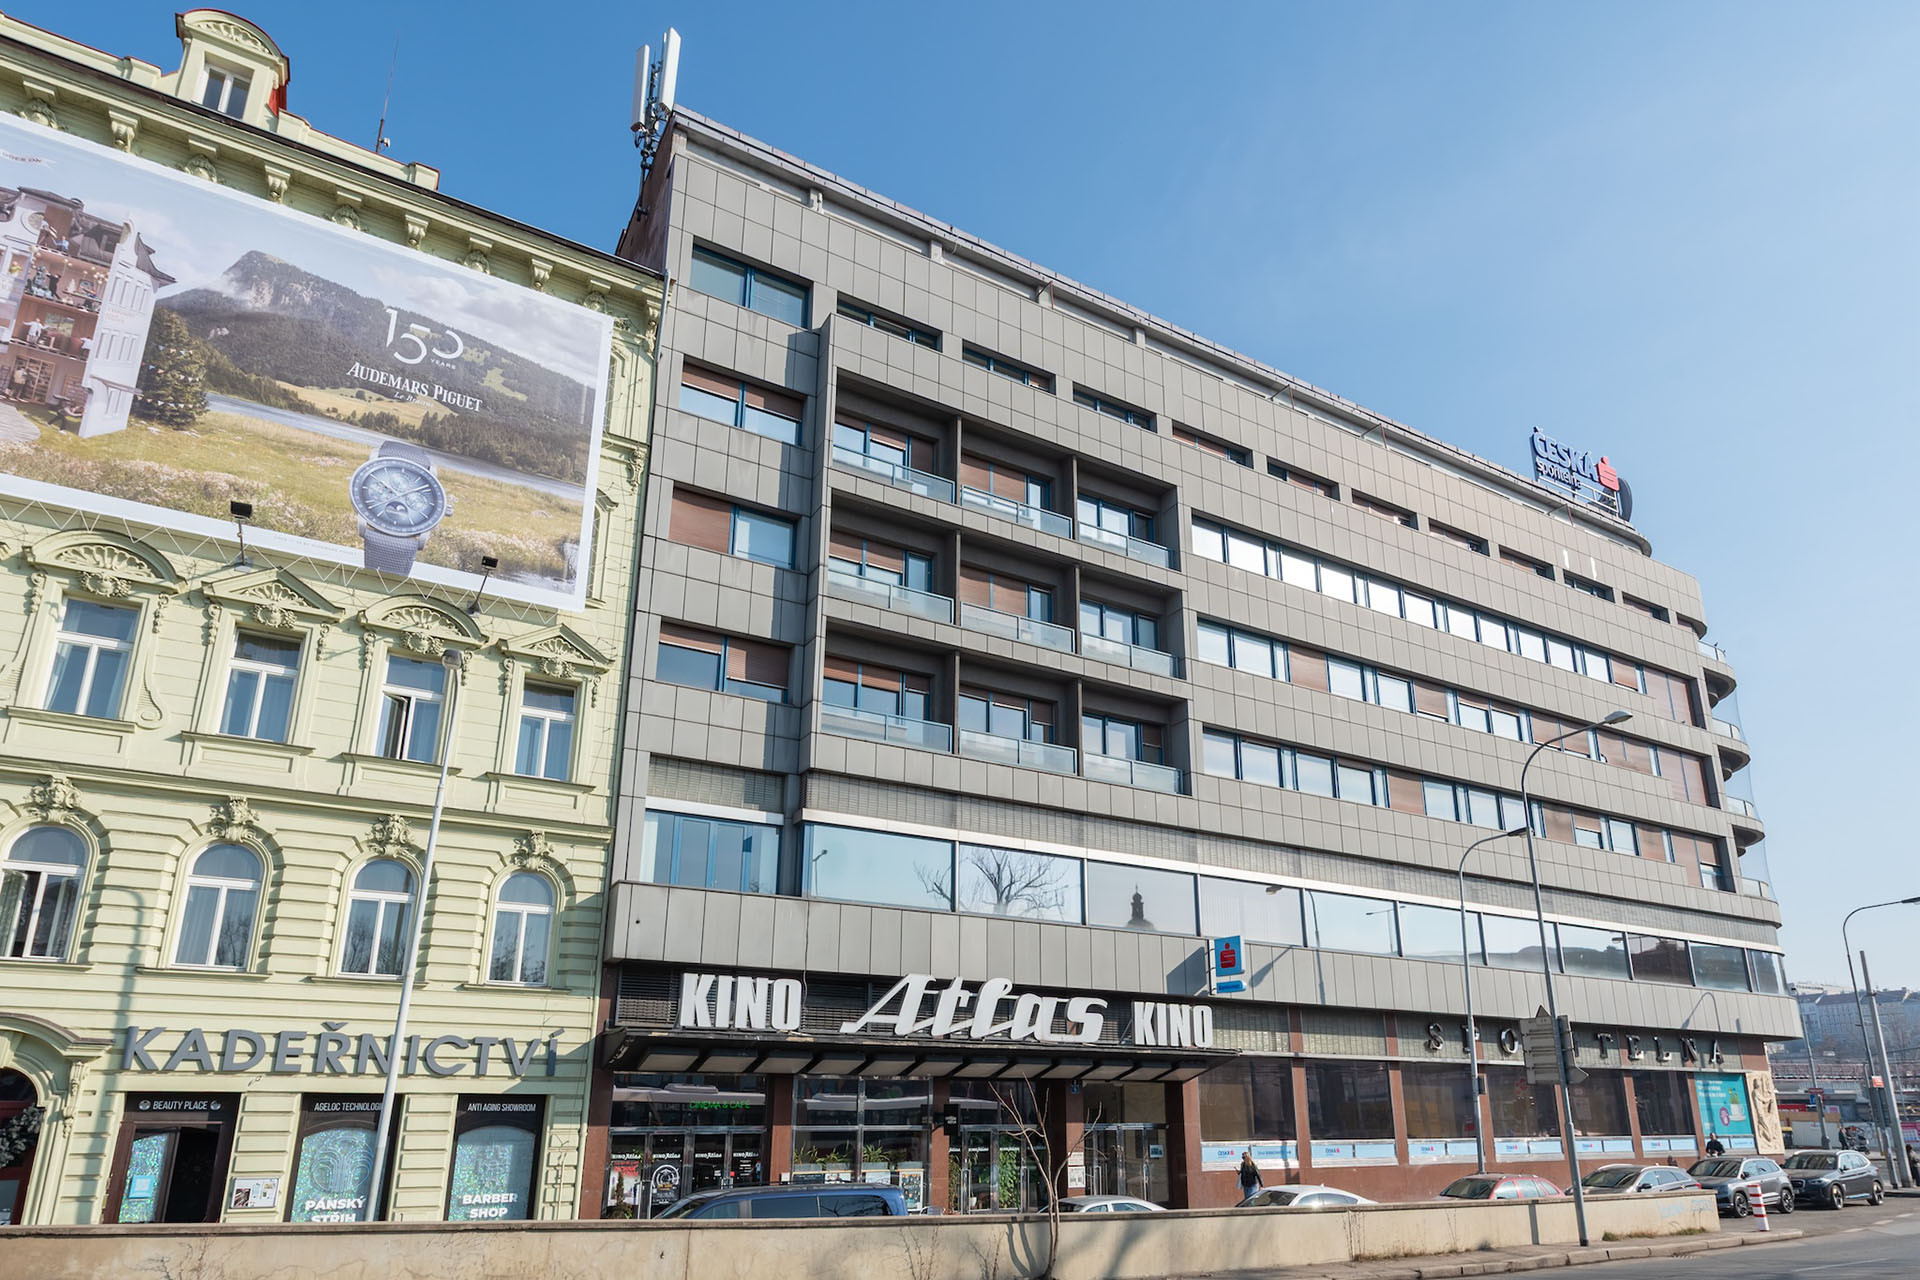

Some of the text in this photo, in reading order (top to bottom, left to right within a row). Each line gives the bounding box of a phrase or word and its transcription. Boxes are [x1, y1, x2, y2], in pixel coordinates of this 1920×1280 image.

[430, 358, 457, 370] YEARS
[346, 362, 429, 397] AUDEMARS
[432, 384, 483, 412] PIGUET
[1530, 426, 1599, 483] ČESKÁ
[680, 973, 801, 1031] KINO
[839, 974, 1108, 1044] Atlas
[1134, 1001, 1213, 1048] KINO
[121, 1021, 565, 1078] KADEŘNICTVÍ
[152, 1101, 209, 1110] BEAUTY PLACE
[467, 1104, 537, 1112] ANTI AGING SHOWROOM
[305, 1196, 367, 1210] PÁNSKÝ
[462, 1193, 518, 1205] BARBER
[311, 1211, 356, 1222] STŘIH
[469, 1207, 508, 1218] SHOP
